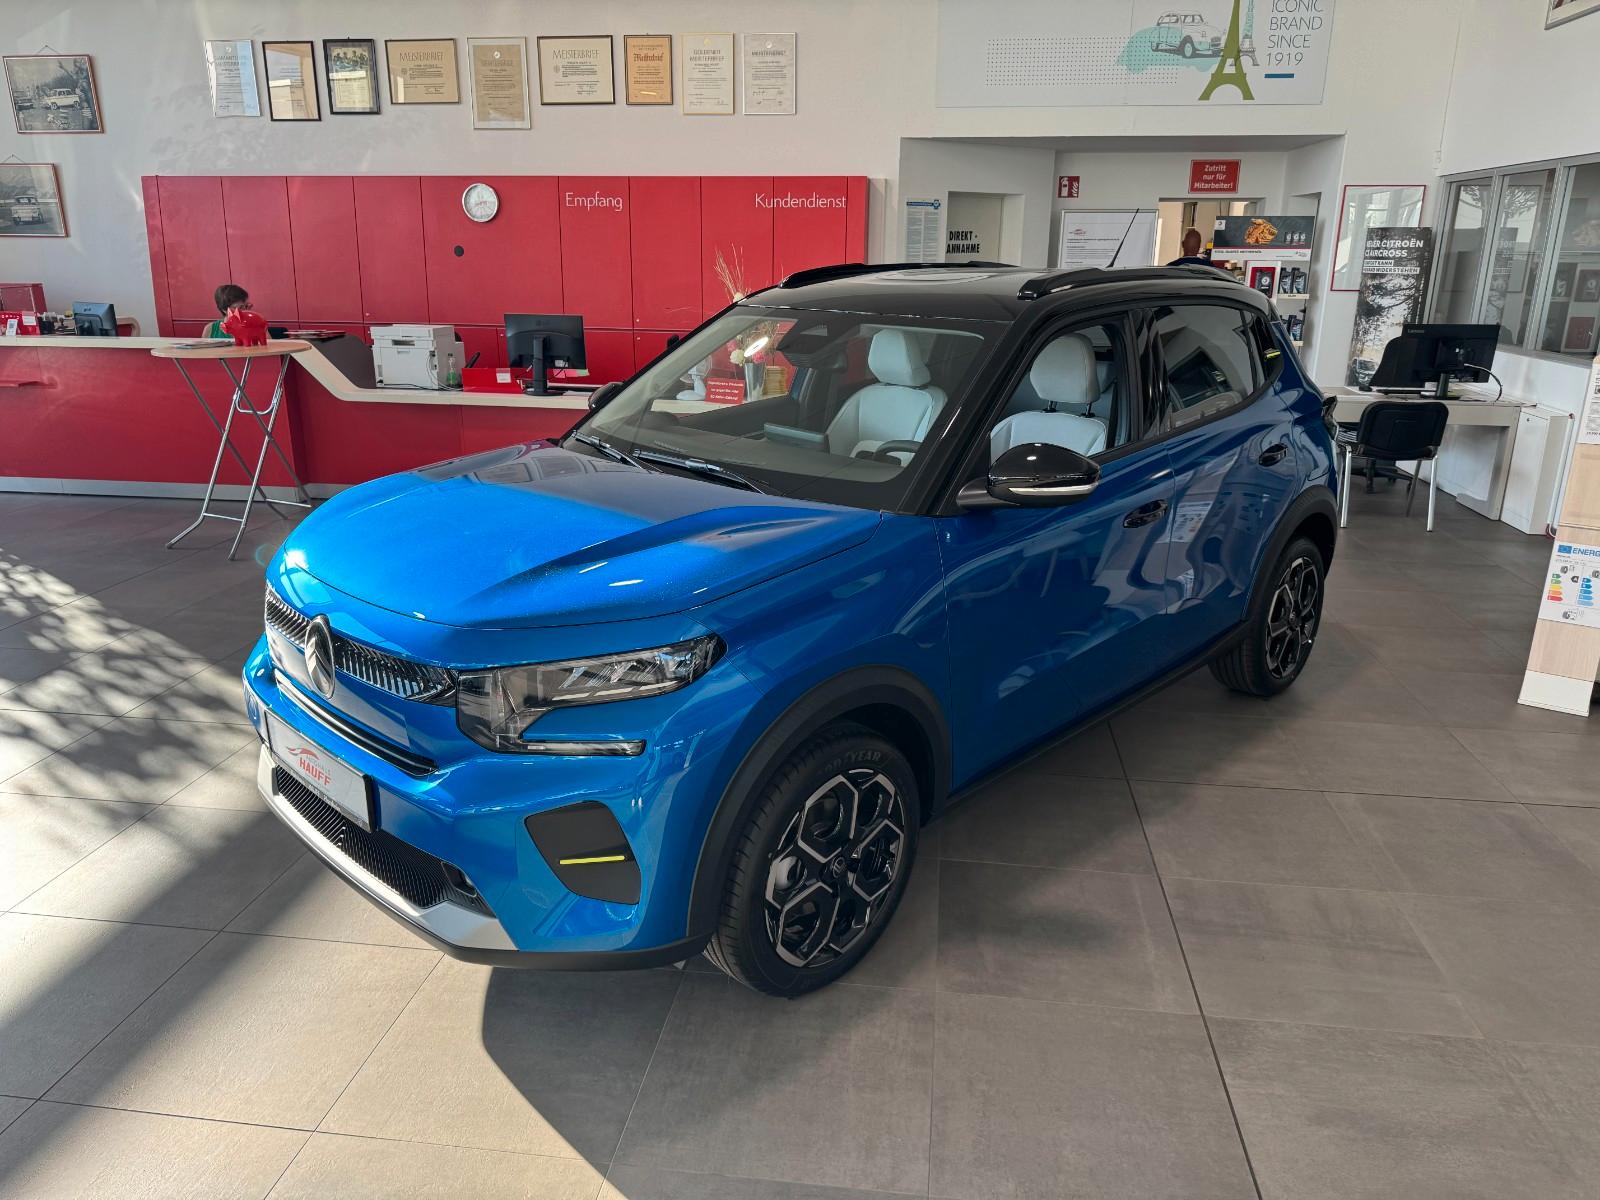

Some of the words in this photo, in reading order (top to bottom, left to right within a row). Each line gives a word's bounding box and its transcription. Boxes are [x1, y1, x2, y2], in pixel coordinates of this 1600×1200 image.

[1271, 0, 1324, 13] ICONIC
[1269, 16, 1323, 31] BRAND
[1267, 34, 1312, 49] SINCE
[552, 49, 600, 60] MEISTERBRIEF
[1266, 51, 1304, 66] 1919
[1204, 164, 1227, 172] Zutritt
[565, 192, 623, 212] Empfang
[755, 192, 847, 208] Kundendienst
[949, 231, 973, 241] DIREKT
[946, 243, 980, 254] ANNAHME
[1381, 238, 1424, 248] CITROËN
[1573, 547, 1600, 557] ENERG
[299, 757, 332, 786] HAUFF
